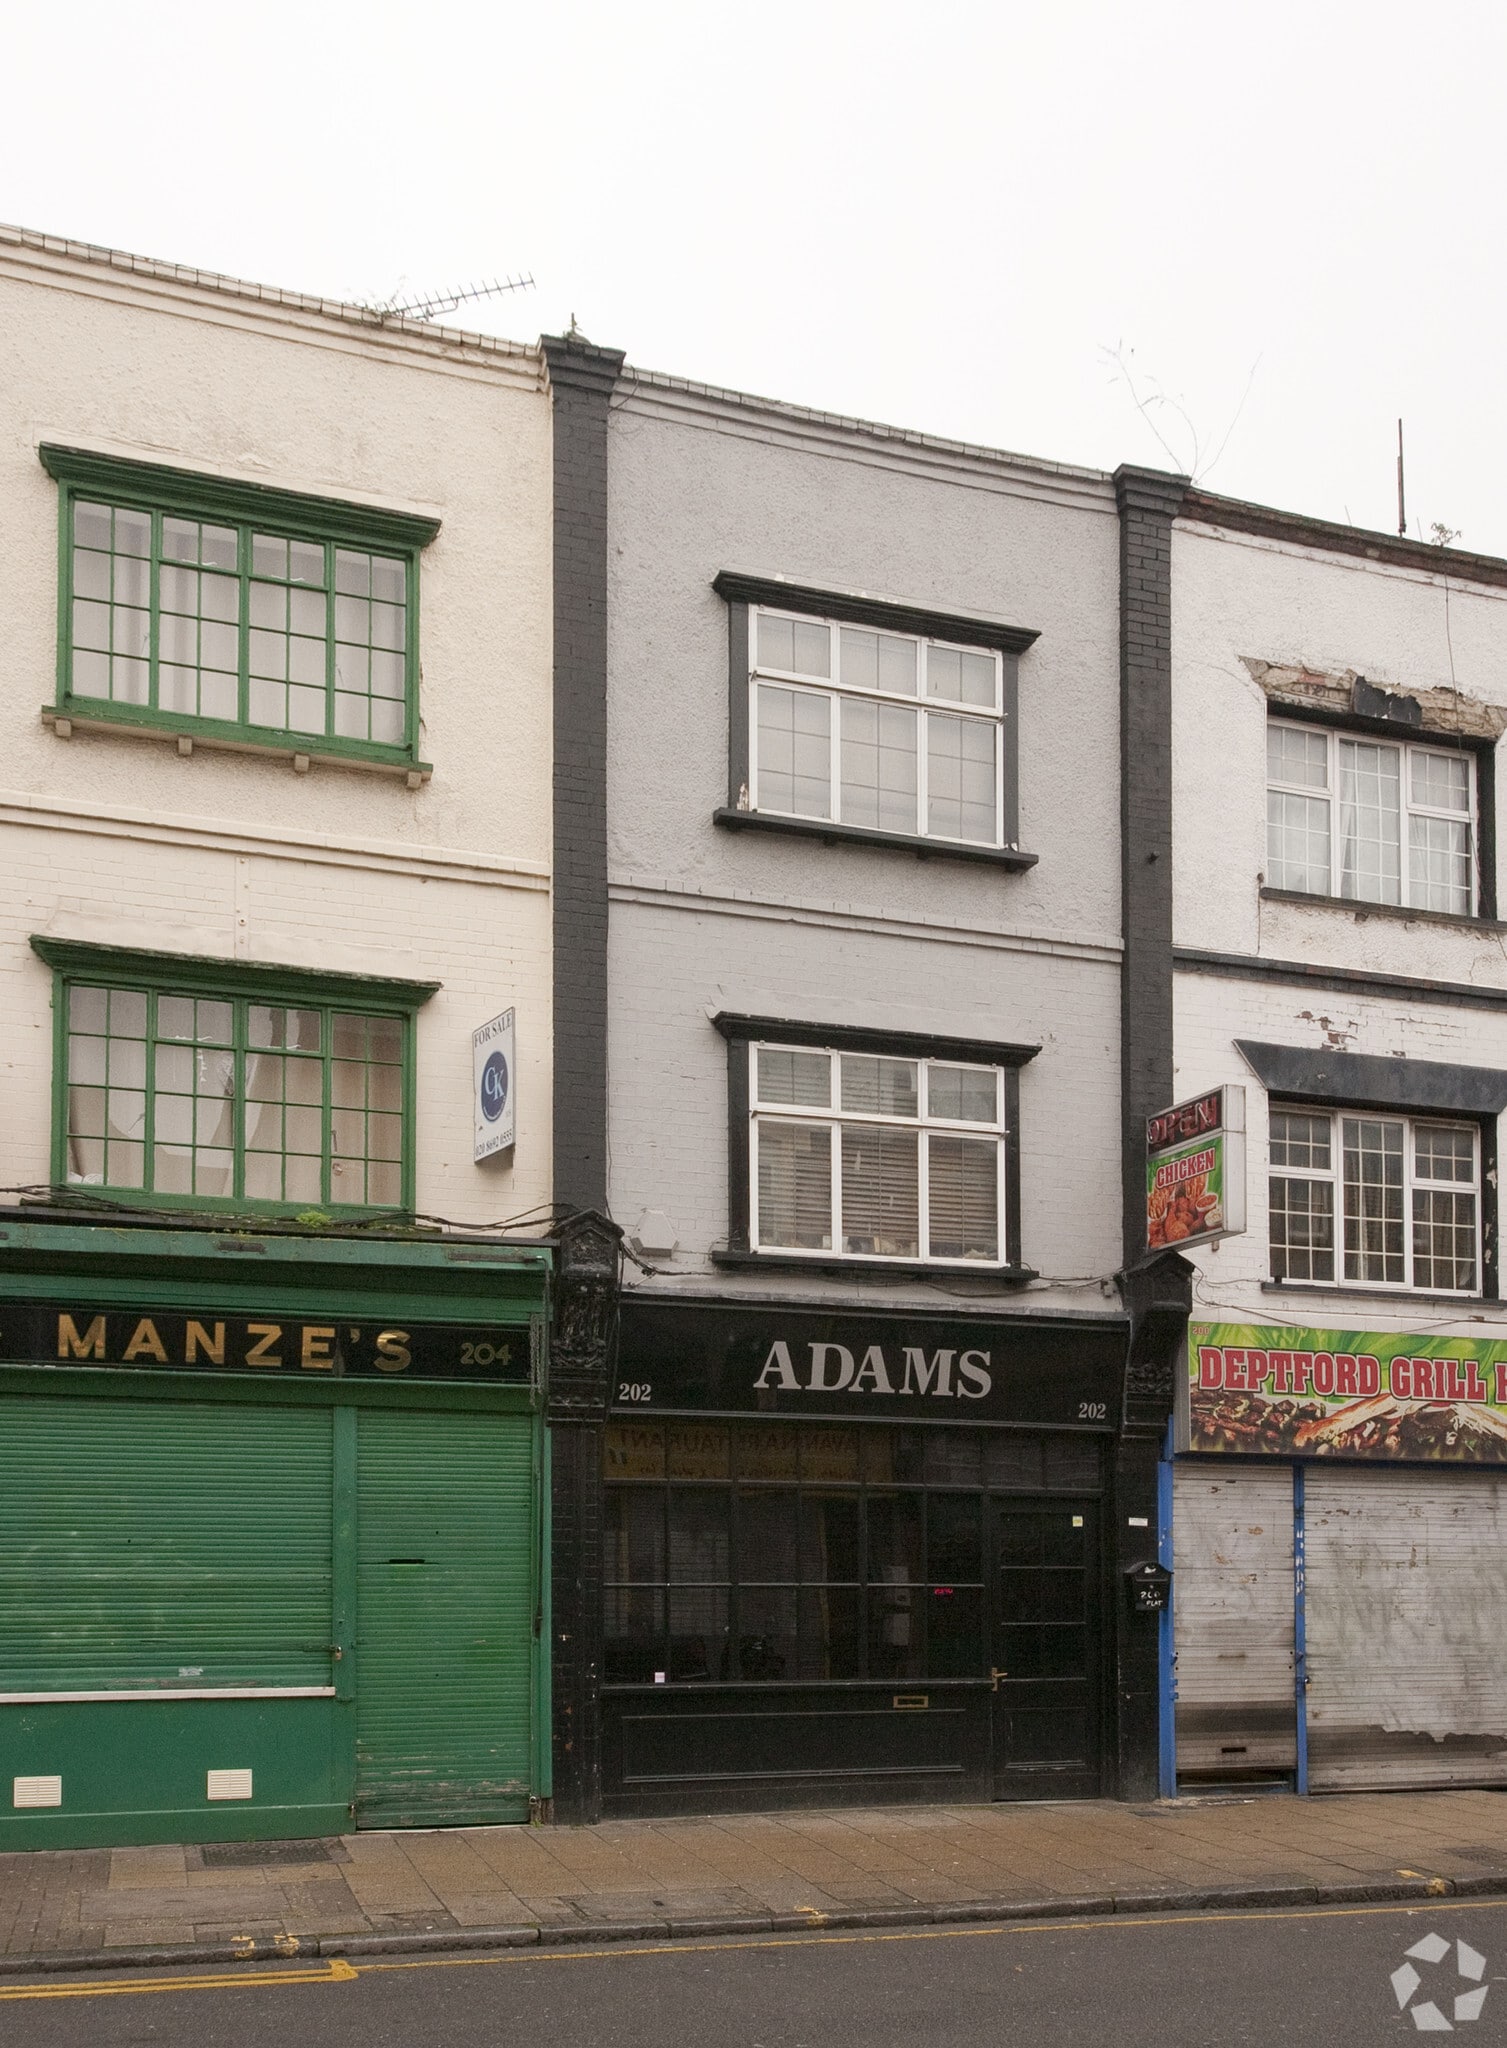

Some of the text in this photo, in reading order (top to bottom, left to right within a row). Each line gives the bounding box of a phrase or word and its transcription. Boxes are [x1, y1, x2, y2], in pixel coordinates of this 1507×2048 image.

[474, 1012, 512, 1048] FOR SALE
[1147, 1096, 1217, 1145] OPEN
[1156, 1148, 1216, 1188] CHICKEN
[57, 1313, 512, 1372] MANZE'S 204
[753, 1341, 992, 1399] ADAMS
[1198, 1347, 1382, 1397] DEPTFORD
[1389, 1355, 1488, 1403] GRILL
[619, 1383, 652, 1403] 202
[1078, 1403, 1106, 1420] 202
